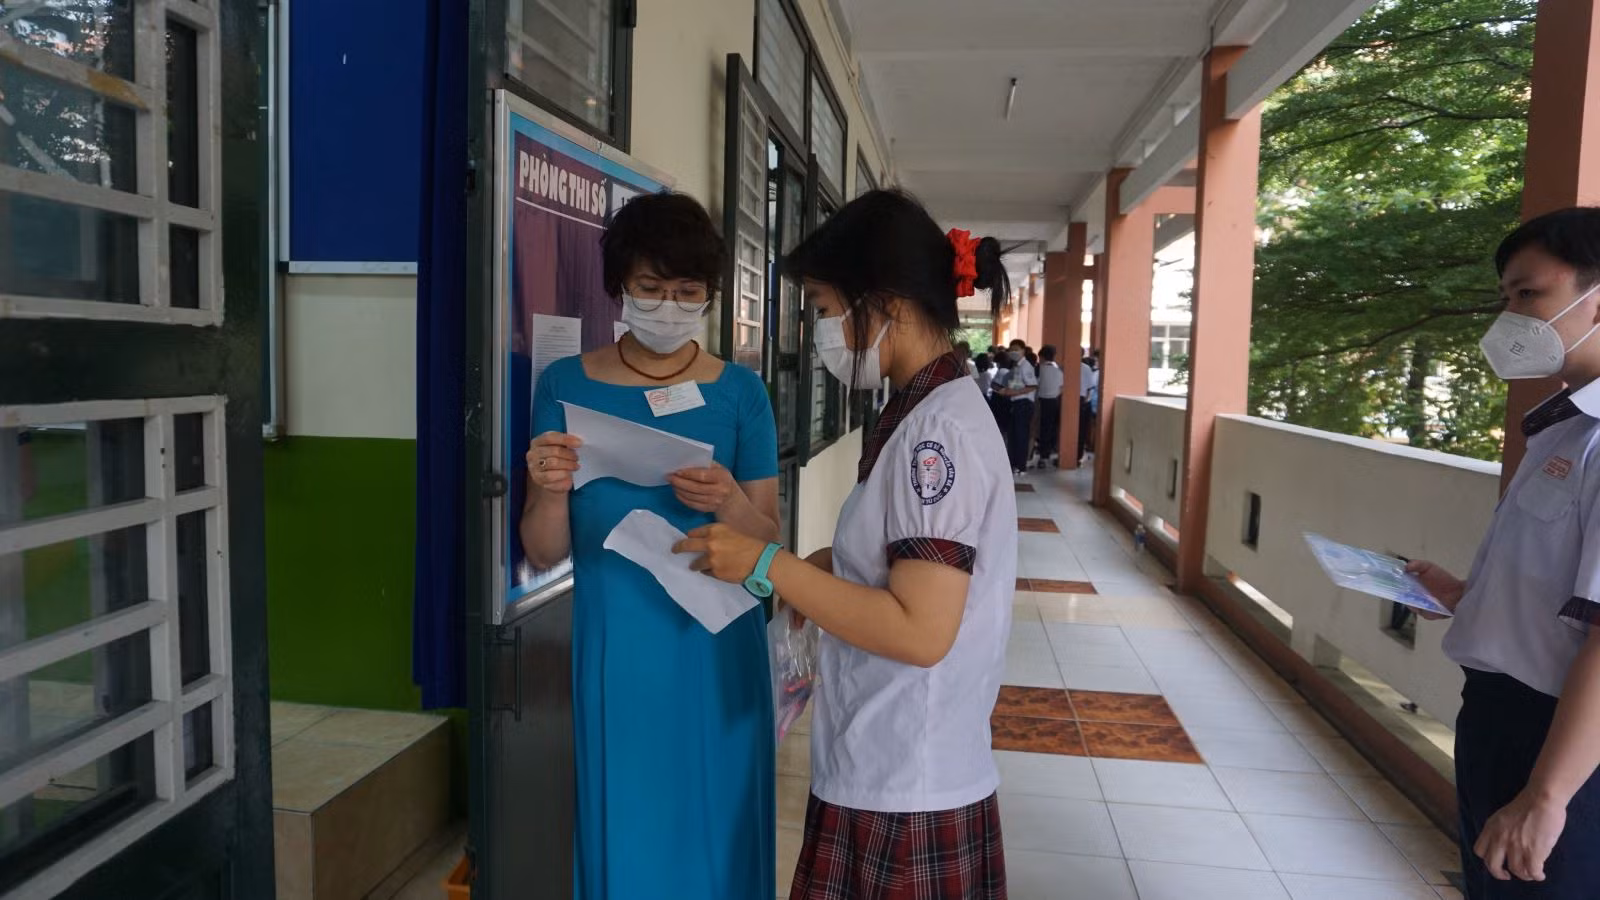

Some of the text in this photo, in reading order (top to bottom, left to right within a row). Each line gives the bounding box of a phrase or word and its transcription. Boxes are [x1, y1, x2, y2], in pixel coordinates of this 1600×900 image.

[519, 150, 568, 205] PHÒNG
[569, 172, 590, 213] THI
[591, 178, 607, 218] SỐ
